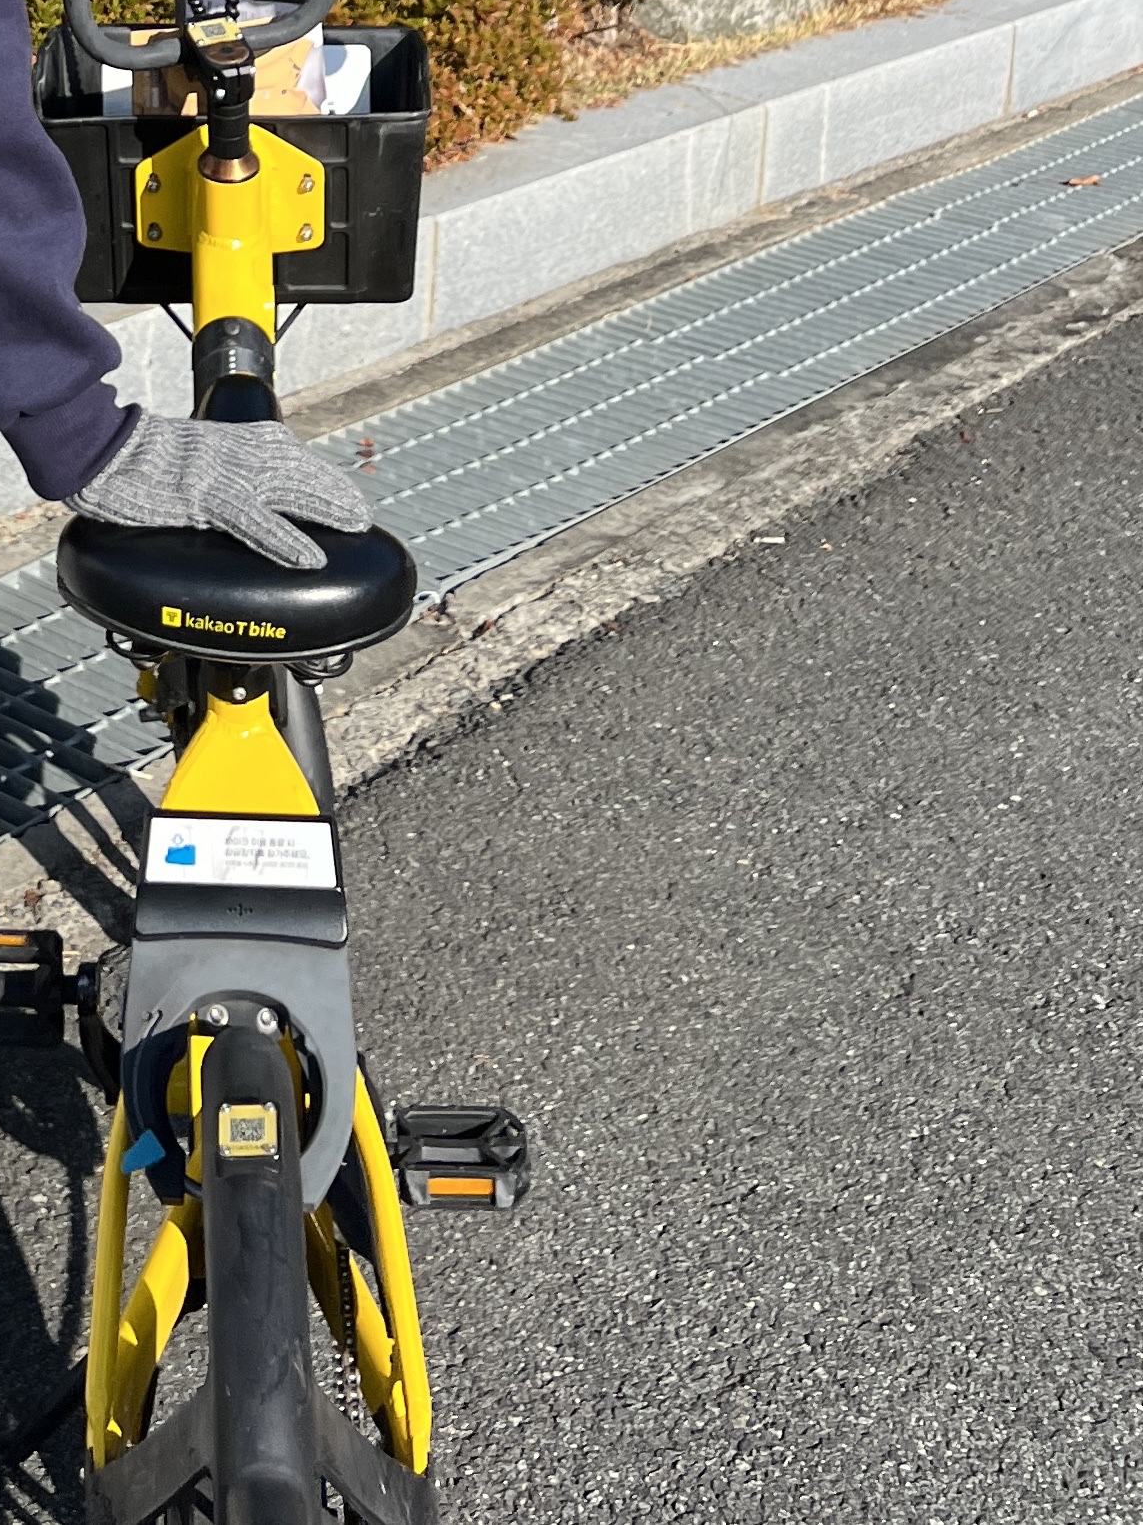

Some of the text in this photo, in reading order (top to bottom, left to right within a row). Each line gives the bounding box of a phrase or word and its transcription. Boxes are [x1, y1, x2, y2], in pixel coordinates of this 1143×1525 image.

[185, 612, 235, 634] kakao
[236, 621, 248, 636] T
[249, 621, 287, 639] bike
